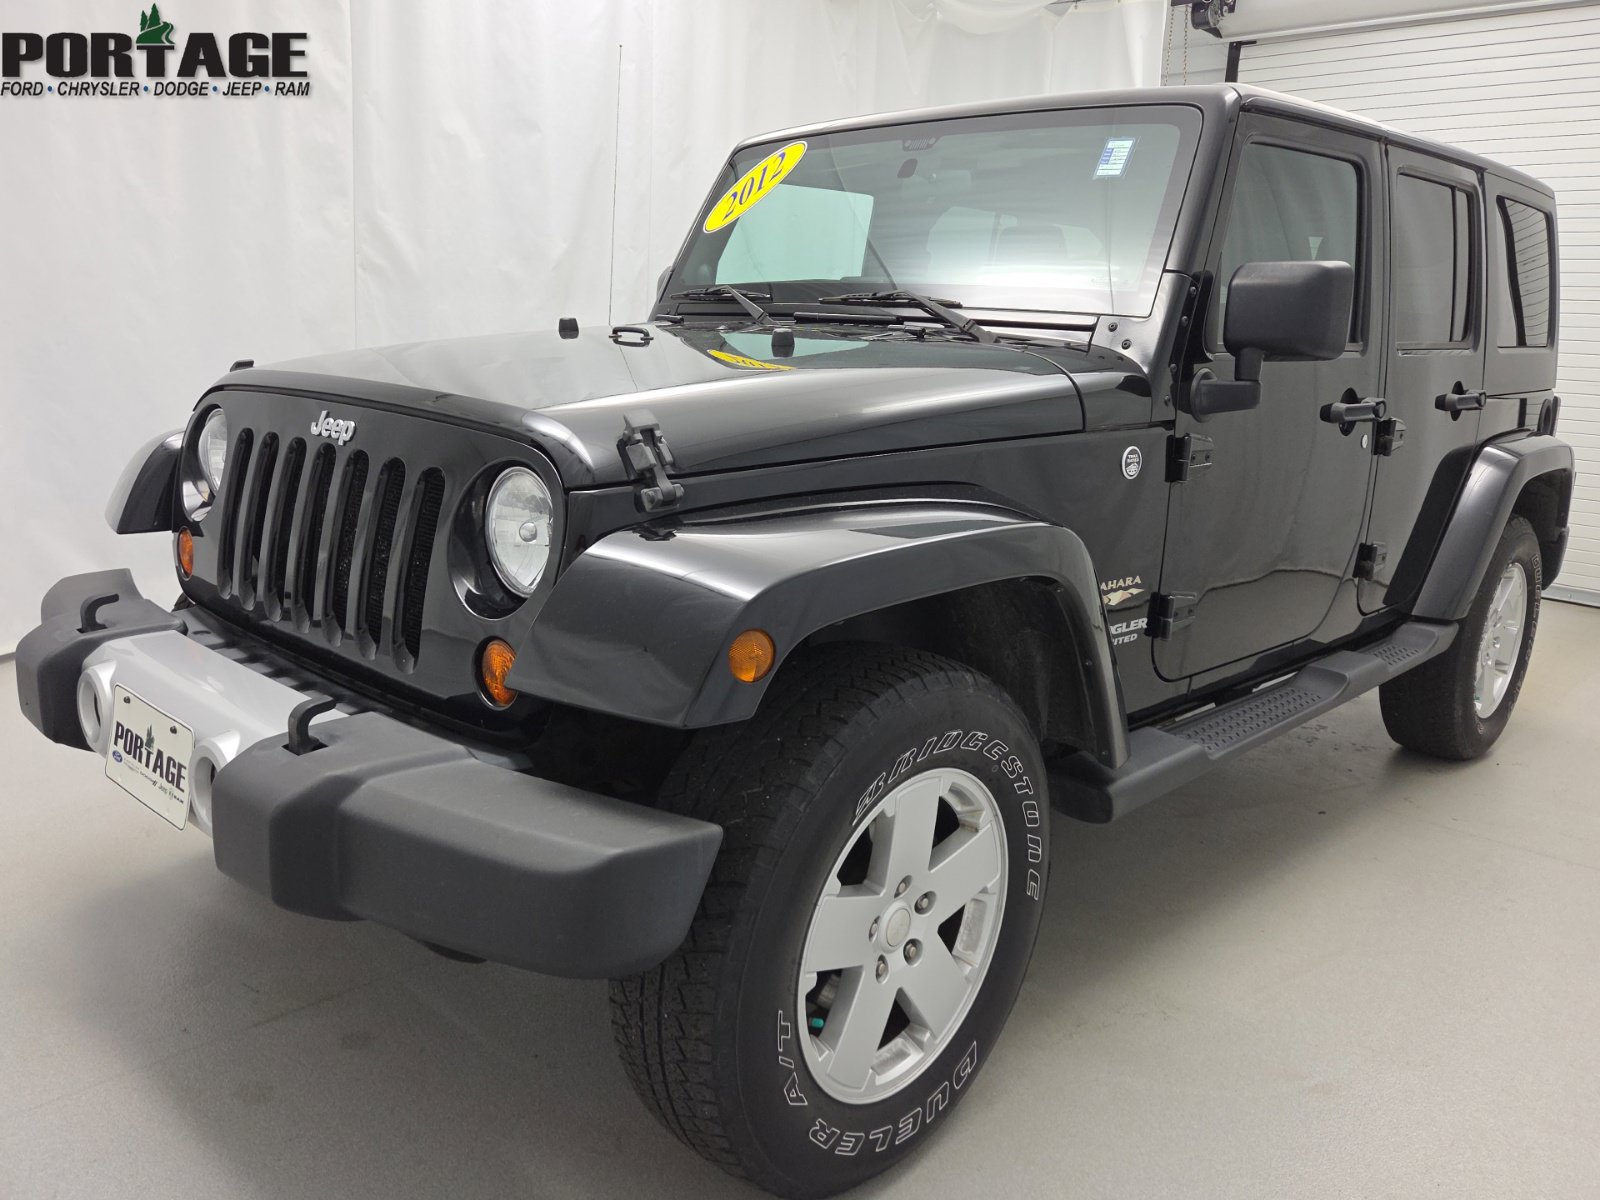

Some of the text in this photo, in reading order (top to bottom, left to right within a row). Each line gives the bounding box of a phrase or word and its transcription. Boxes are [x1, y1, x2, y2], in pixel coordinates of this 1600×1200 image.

[721, 151, 786, 222] 2012
[311, 410, 356, 446] Jeep
[1101, 575, 1142, 590] AHARA
[113, 721, 187, 793] PORTAGE
[852, 729, 1042, 901] BRIDGESTONE
[777, 1010, 977, 1156] DUELER A/T
